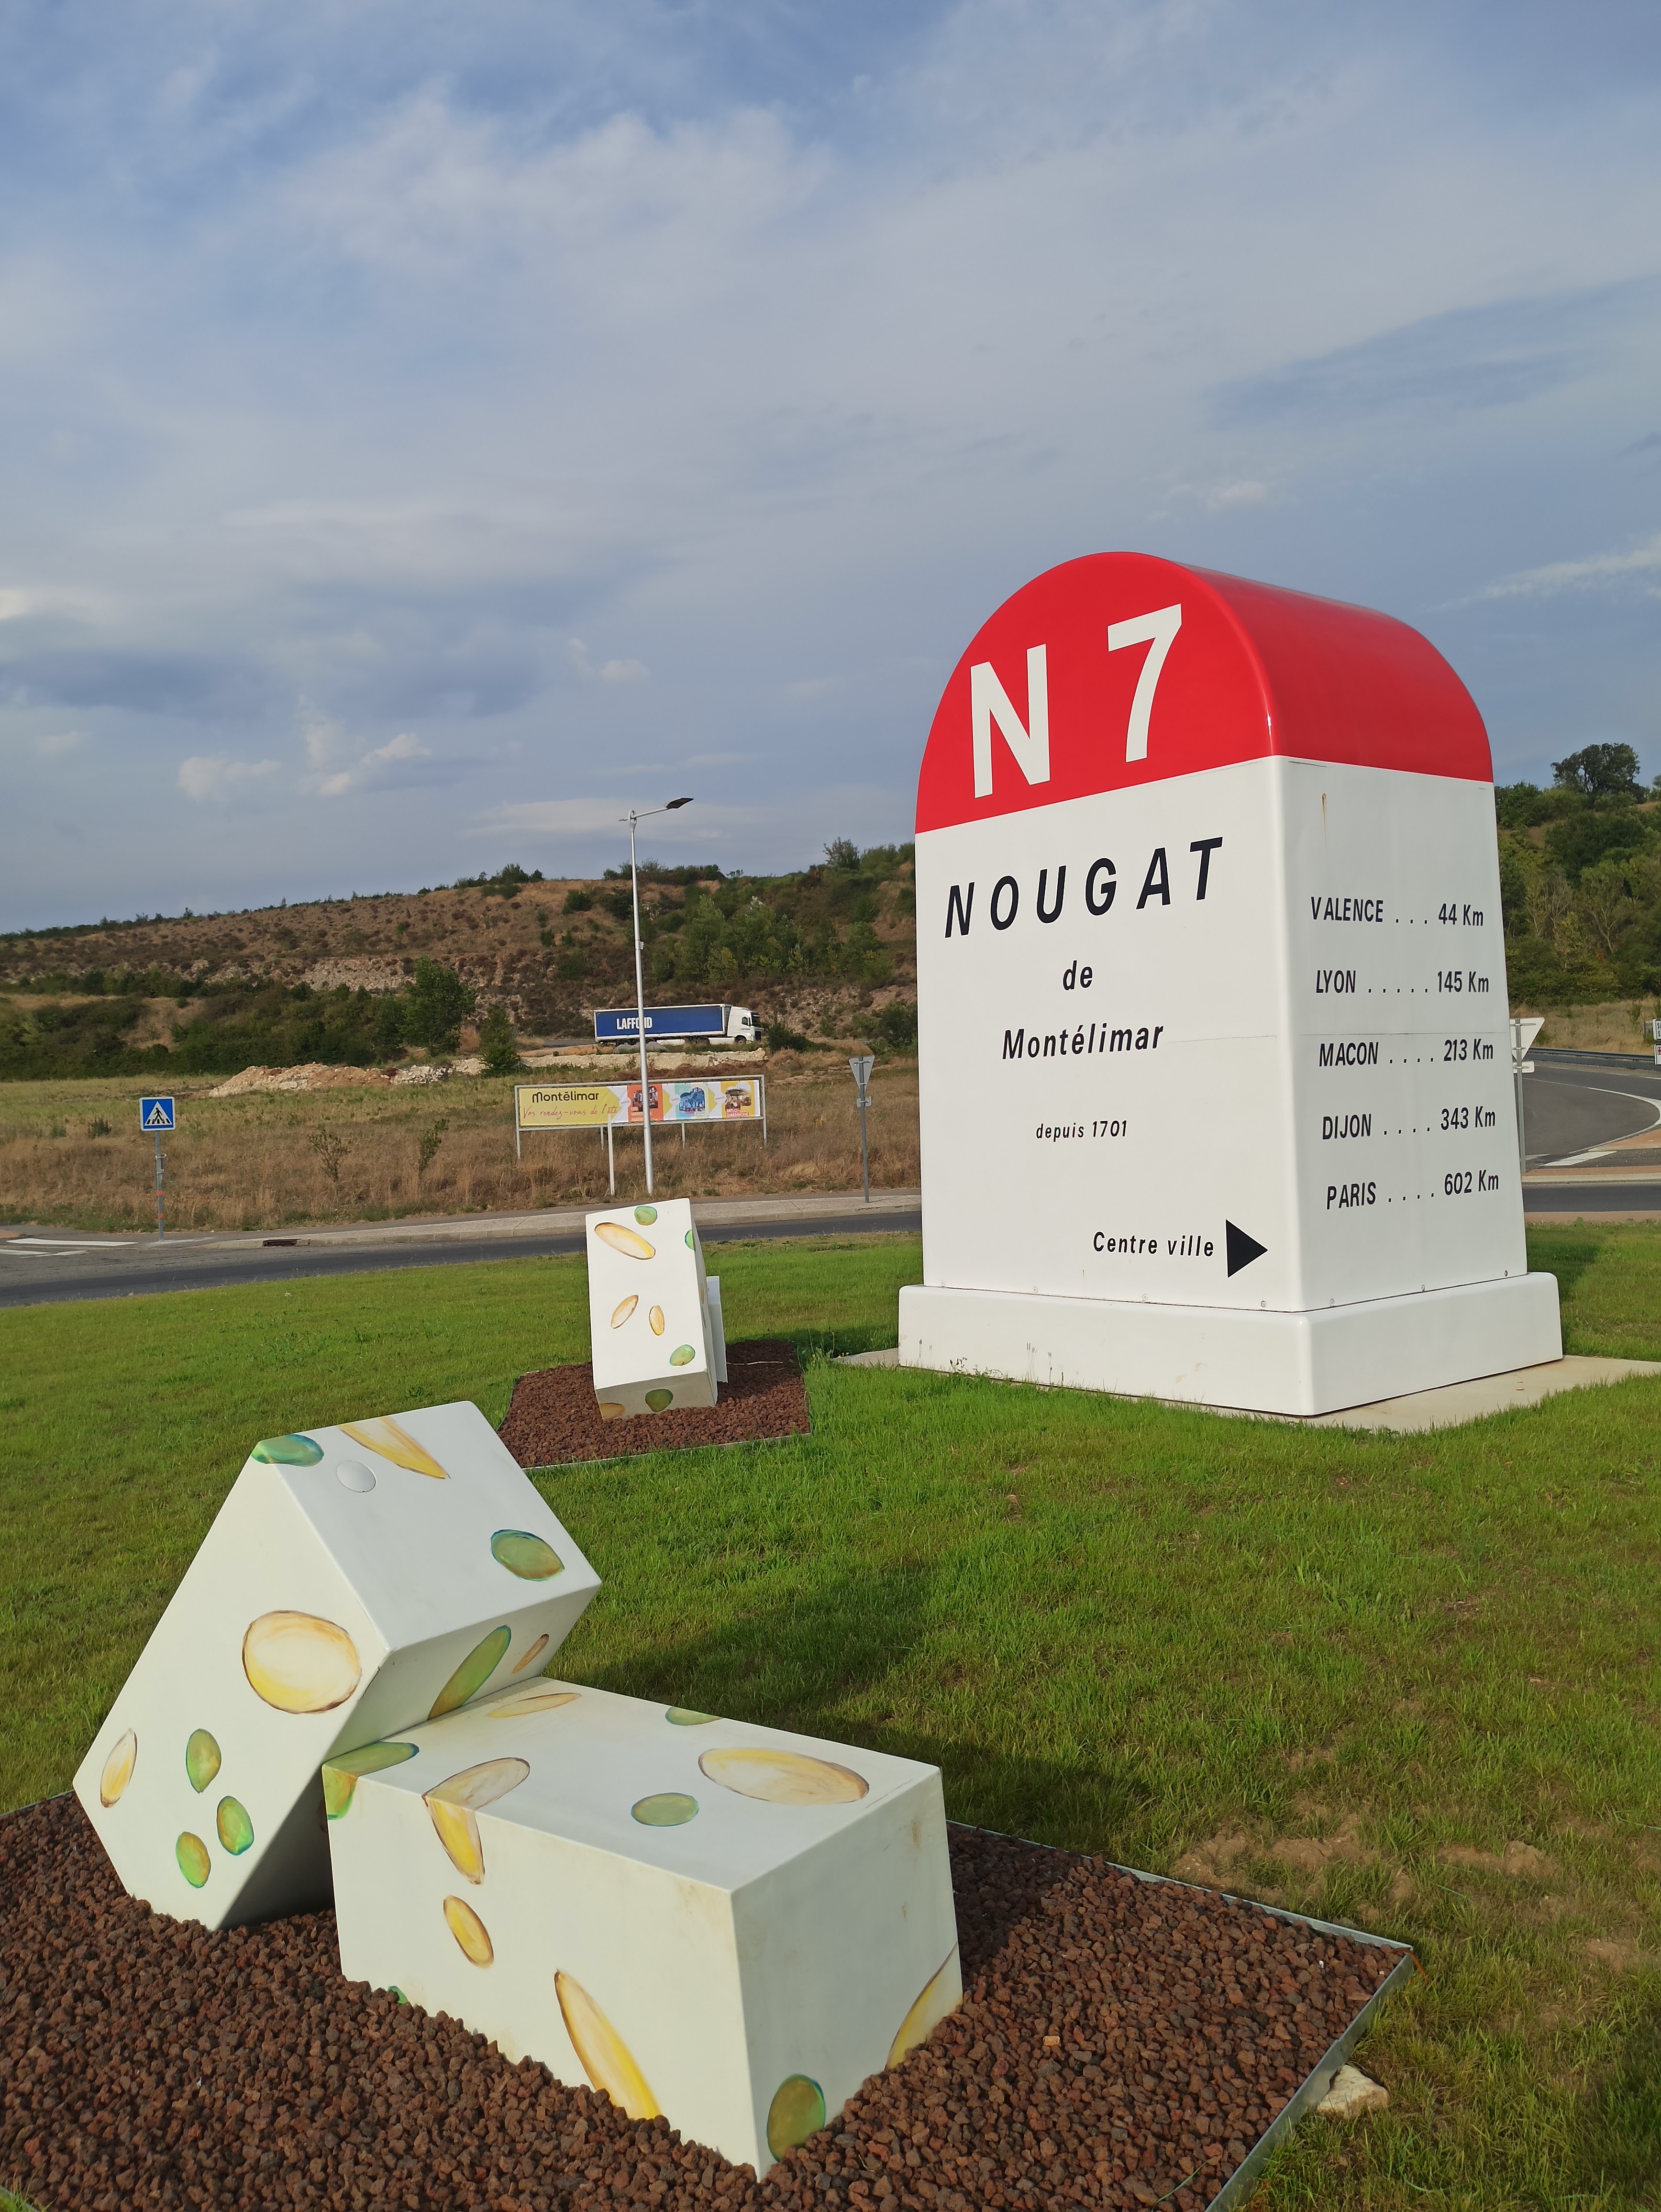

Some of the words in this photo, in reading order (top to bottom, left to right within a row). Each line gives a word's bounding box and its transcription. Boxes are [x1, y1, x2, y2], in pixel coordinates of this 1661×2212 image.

[970, 643, 1050, 798] N
[1108, 604, 1182, 762] 7
[945, 837, 1223, 938] NOUGAT
[1311, 897, 1383, 922] VALENCE
[1439, 904, 1457, 925] 44
[1463, 905, 1483, 926] Km
[1063, 960, 1092, 990] de
[1316, 970, 1355, 993] LYON
[1438, 971, 1462, 992] 145
[1469, 972, 1488, 992] Km
[1003, 1023, 1163, 1059] Montélimar
[1319, 1042, 1378, 1066] MACON
[1444, 1040, 1467, 1061] 213
[1473, 1039, 1493, 1060] Km
[523, 1106, 535, 1119] Vos
[540, 1106, 586, 1120] rendez-vous
[590, 1105, 598, 1115] de
[1323, 1114, 1371, 1139] DIJON
[1441, 1107, 1468, 1130] 343
[1475, 1106, 1495, 1128] Km
[1037, 1124, 1084, 1142] depuis
[1093, 1120, 1126, 1137] 1701
[1327, 1182, 1376, 1209] PARIS
[1445, 1172, 1472, 1195] 602
[1479, 1170, 1498, 1191] Km
[1094, 1232, 1157, 1254] Centre
[1168, 1236, 1213, 1256] ville
